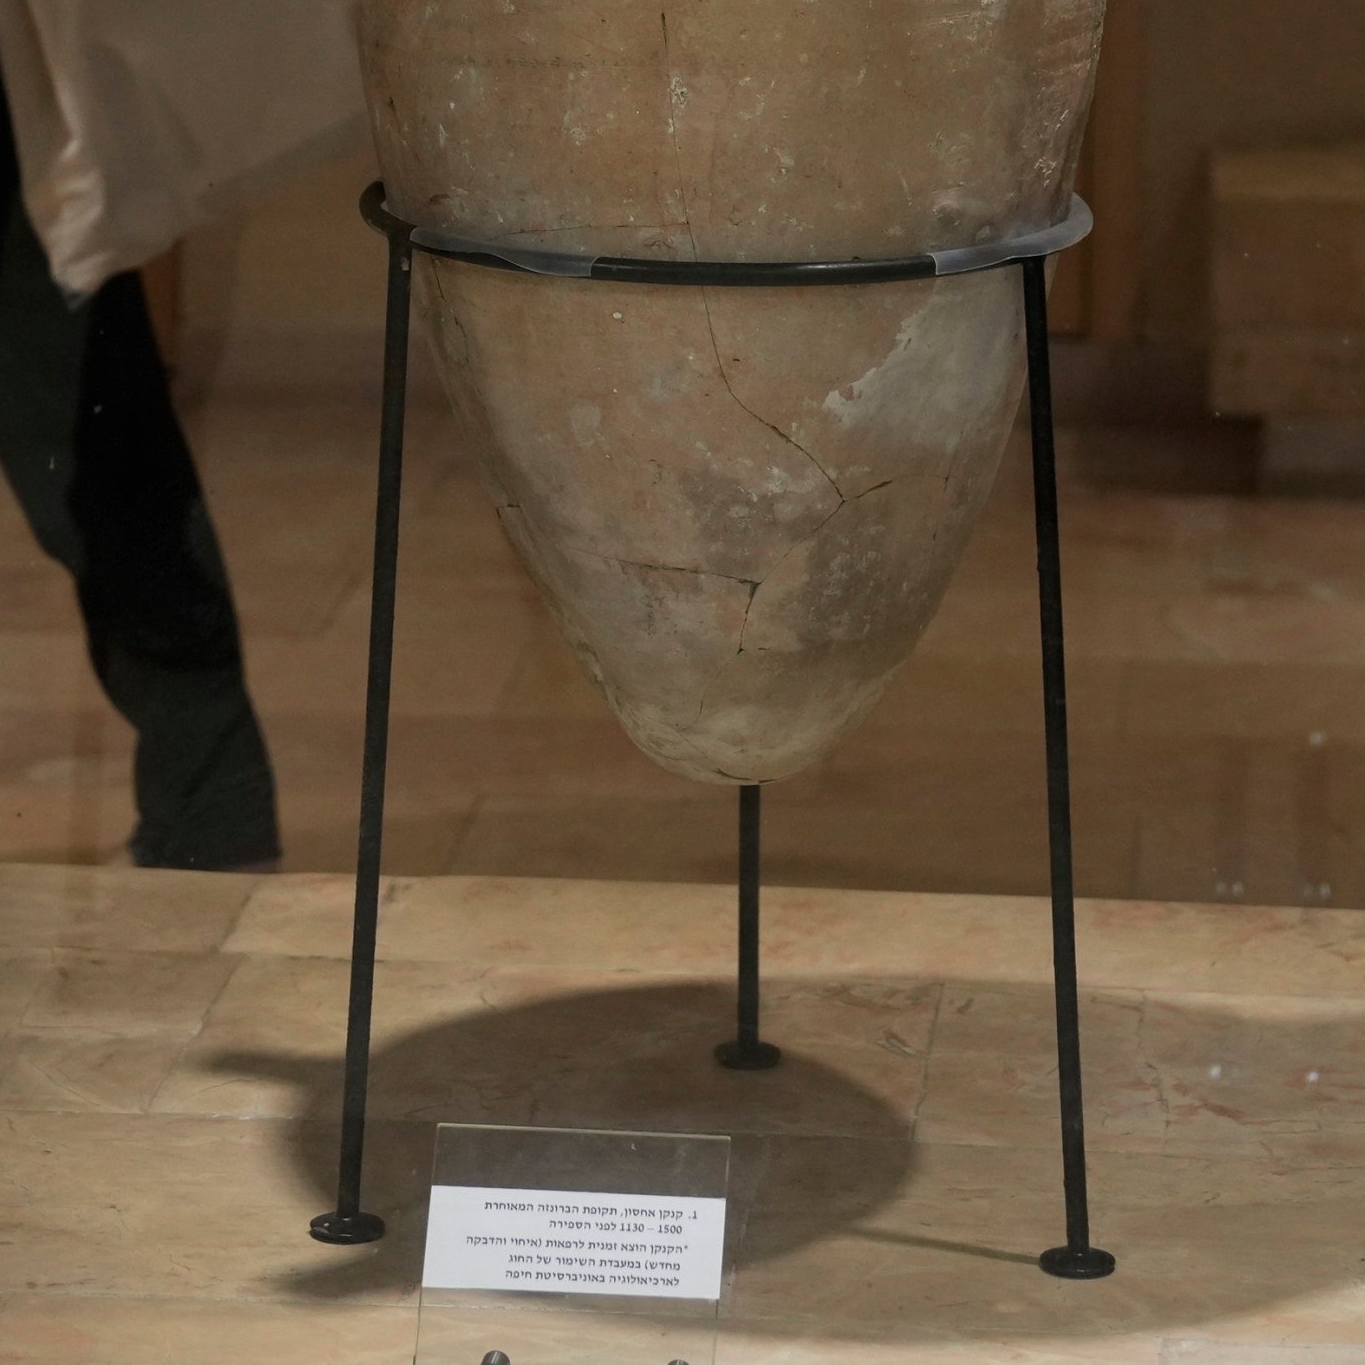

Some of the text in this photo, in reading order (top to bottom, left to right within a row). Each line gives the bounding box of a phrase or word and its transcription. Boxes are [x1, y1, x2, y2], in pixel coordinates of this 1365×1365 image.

[484, 1201, 698, 1221] 1. קנקן אחסון, תקופת הברונזה המאוחרת
[549, 1219, 592, 1231] הספירה
[594, 1221, 618, 1232] לפני
[619, 1222, 645, 1233] 1130
[657, 1223, 683, 1235] 1500
[466, 1235, 507, 1247] והדבקה
[510, 1237, 543, 1249] (איחוי
[544, 1239, 586, 1250] לרפאות
[587, 1241, 618, 1251] זמנית
[620, 1242, 647, 1253] הוצא
[508, 1253, 681, 1272] מחדש) במעבדת השימור של החוג
[505, 1269, 680, 1287] לארכיאולוגיה באוניברסיטת חיפה
